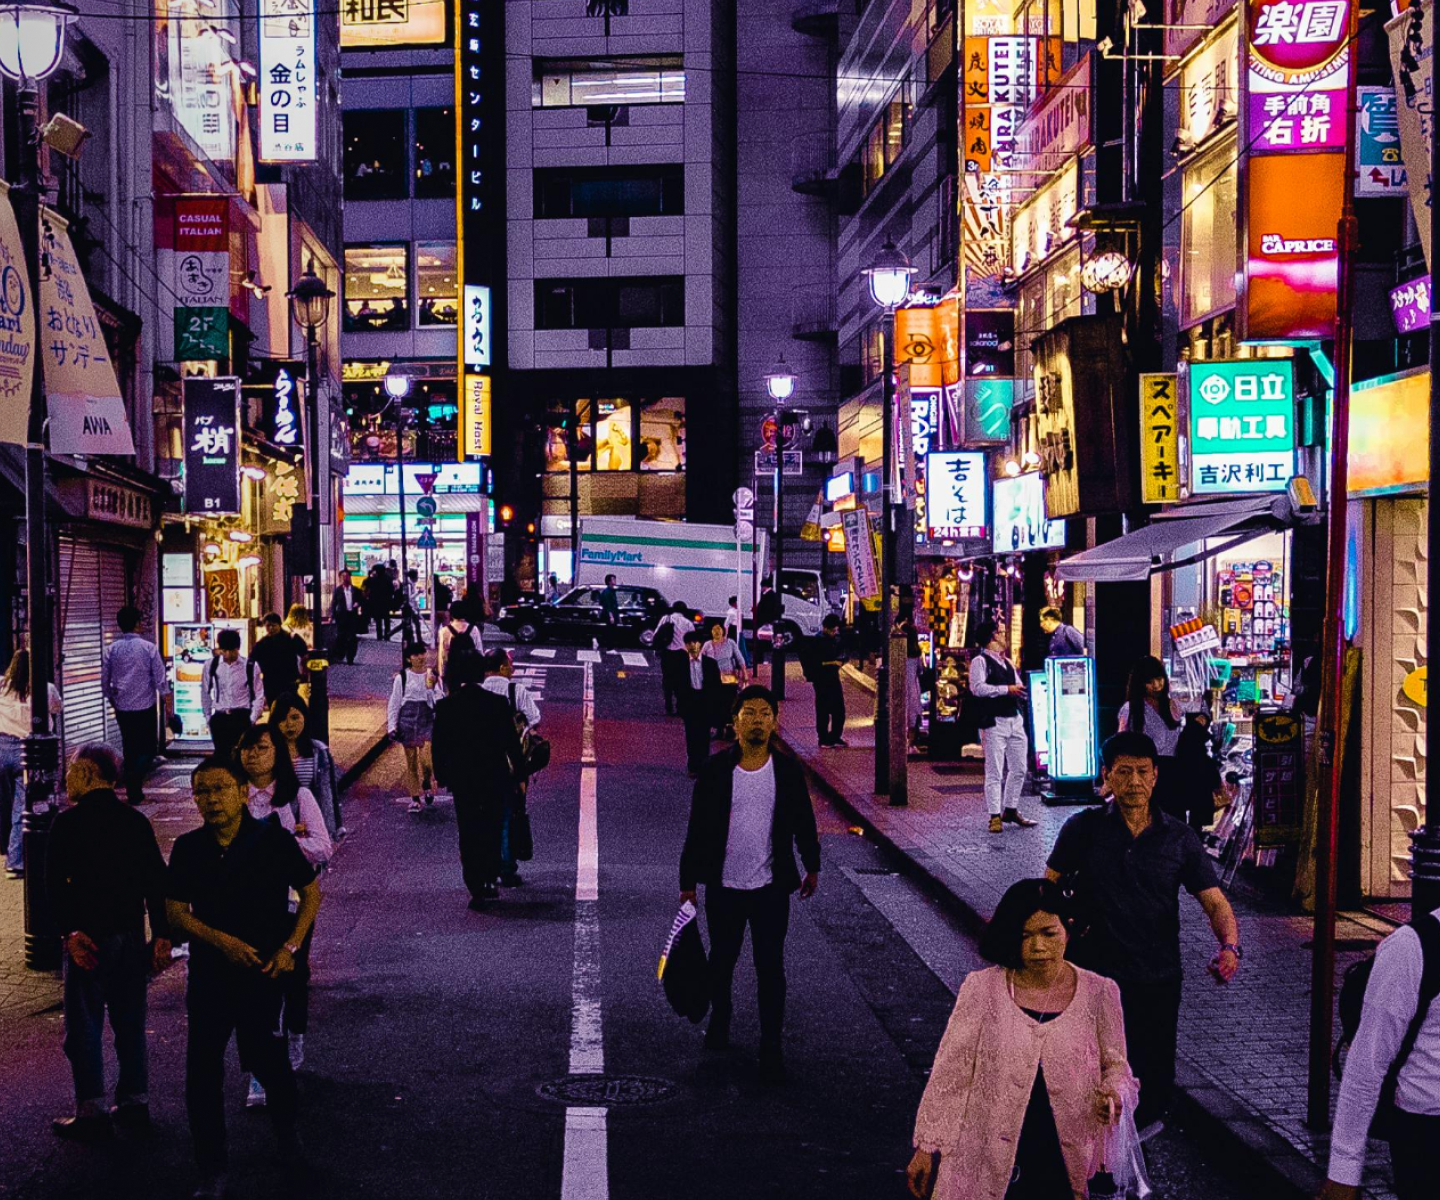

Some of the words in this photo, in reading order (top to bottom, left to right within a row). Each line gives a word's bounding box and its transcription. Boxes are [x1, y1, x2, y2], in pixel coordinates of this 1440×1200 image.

[1252, 0, 1347, 45] 楽園
[294, 46, 307, 108] ラムしゃぶ
[270, 63, 292, 133] 金の目
[1263, 93, 1331, 117] 手前角
[1263, 115, 1332, 145] 右折
[179, 214, 222, 223] CASUAL
[180, 228, 222, 236] ITALIAN
[1262, 239, 1334, 253] CAPRICE
[51, 339, 106, 368] サンデー
[1234, 374, 1286, 401] 日立
[83, 415, 113, 435] AWA
[912, 400, 930, 455] BAR
[190, 426, 233, 454] 梢
[1152, 380, 1173, 498] スペアーキー
[1199, 463, 1286, 485] 吉沢利工
[204, 498, 221, 508] B1
[581, 548, 642, 562] FamilyMart
